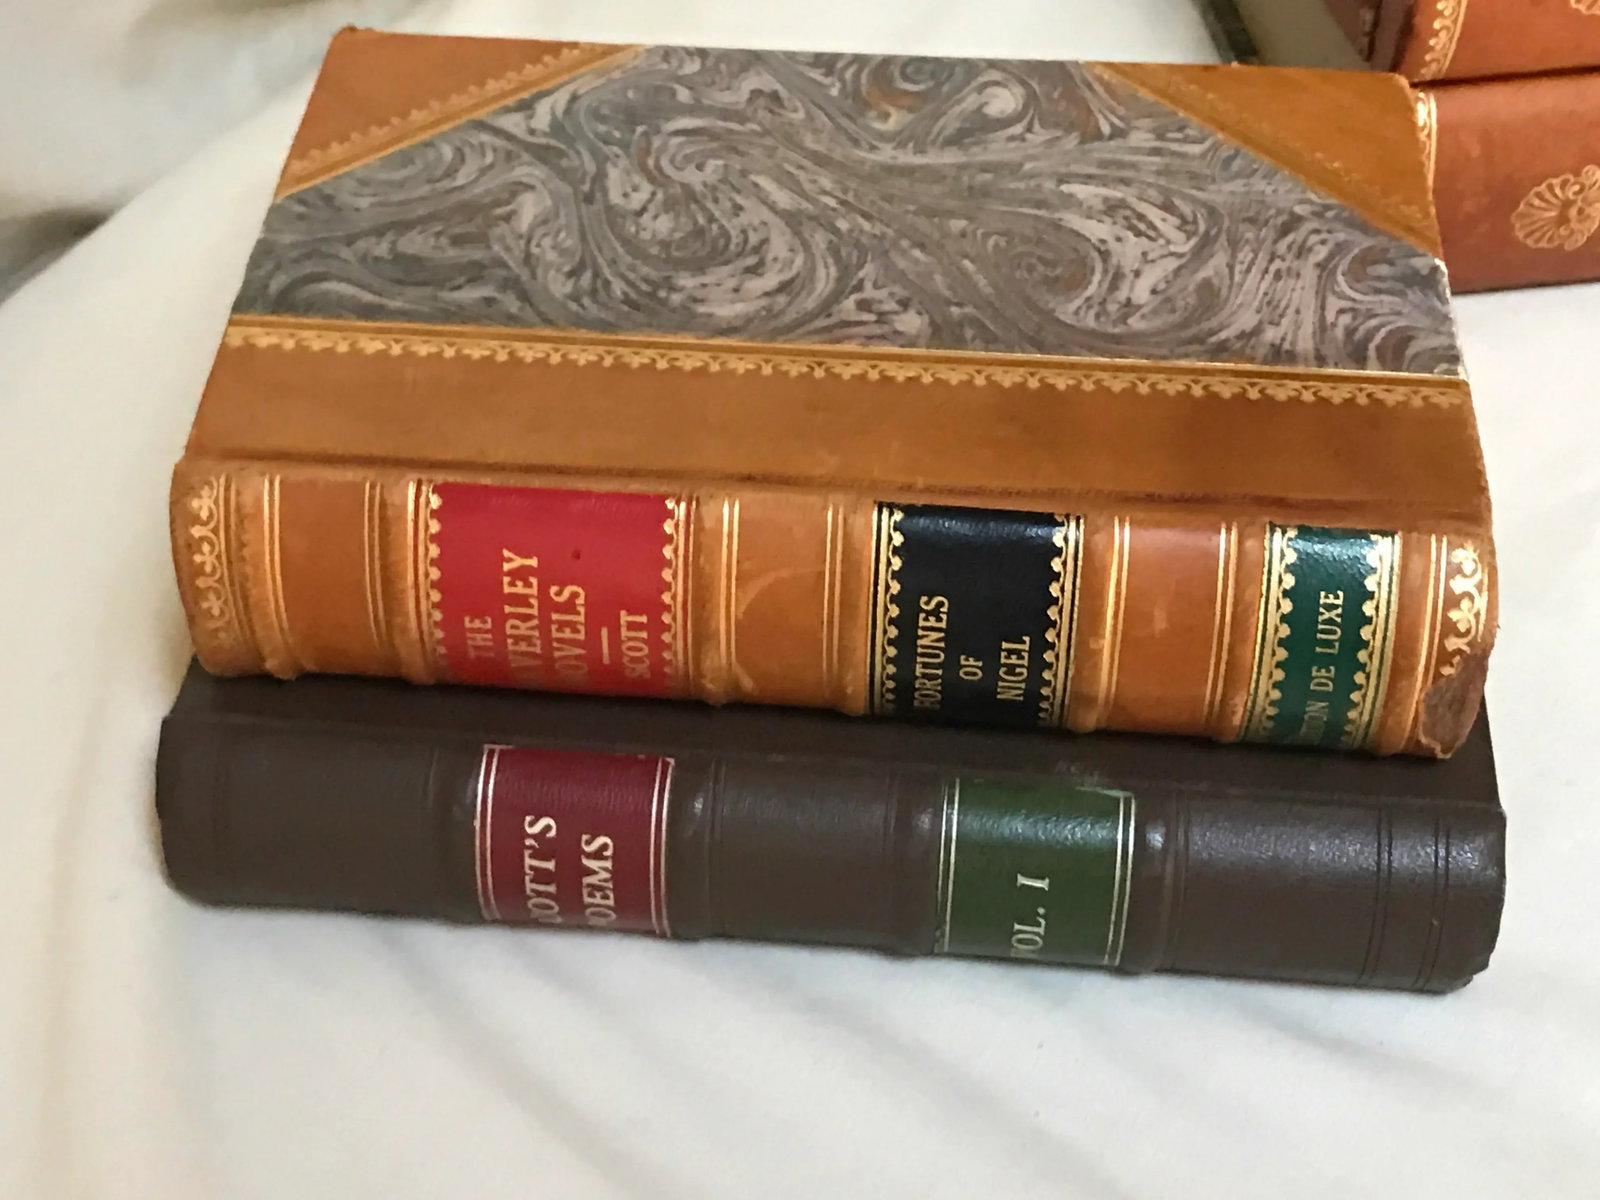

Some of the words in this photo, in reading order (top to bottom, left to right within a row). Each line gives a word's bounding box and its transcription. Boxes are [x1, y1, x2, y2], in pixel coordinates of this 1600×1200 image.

[464, 615, 495, 660] THE
[620, 609, 649, 678] SCOTT
[1315, 590, 1344, 655] LUXE
[959, 654, 983, 680] OF
[997, 635, 1031, 701] NIGEL
[1310, 665, 1335, 692] DE
[1017, 873, 1050, 891] I
